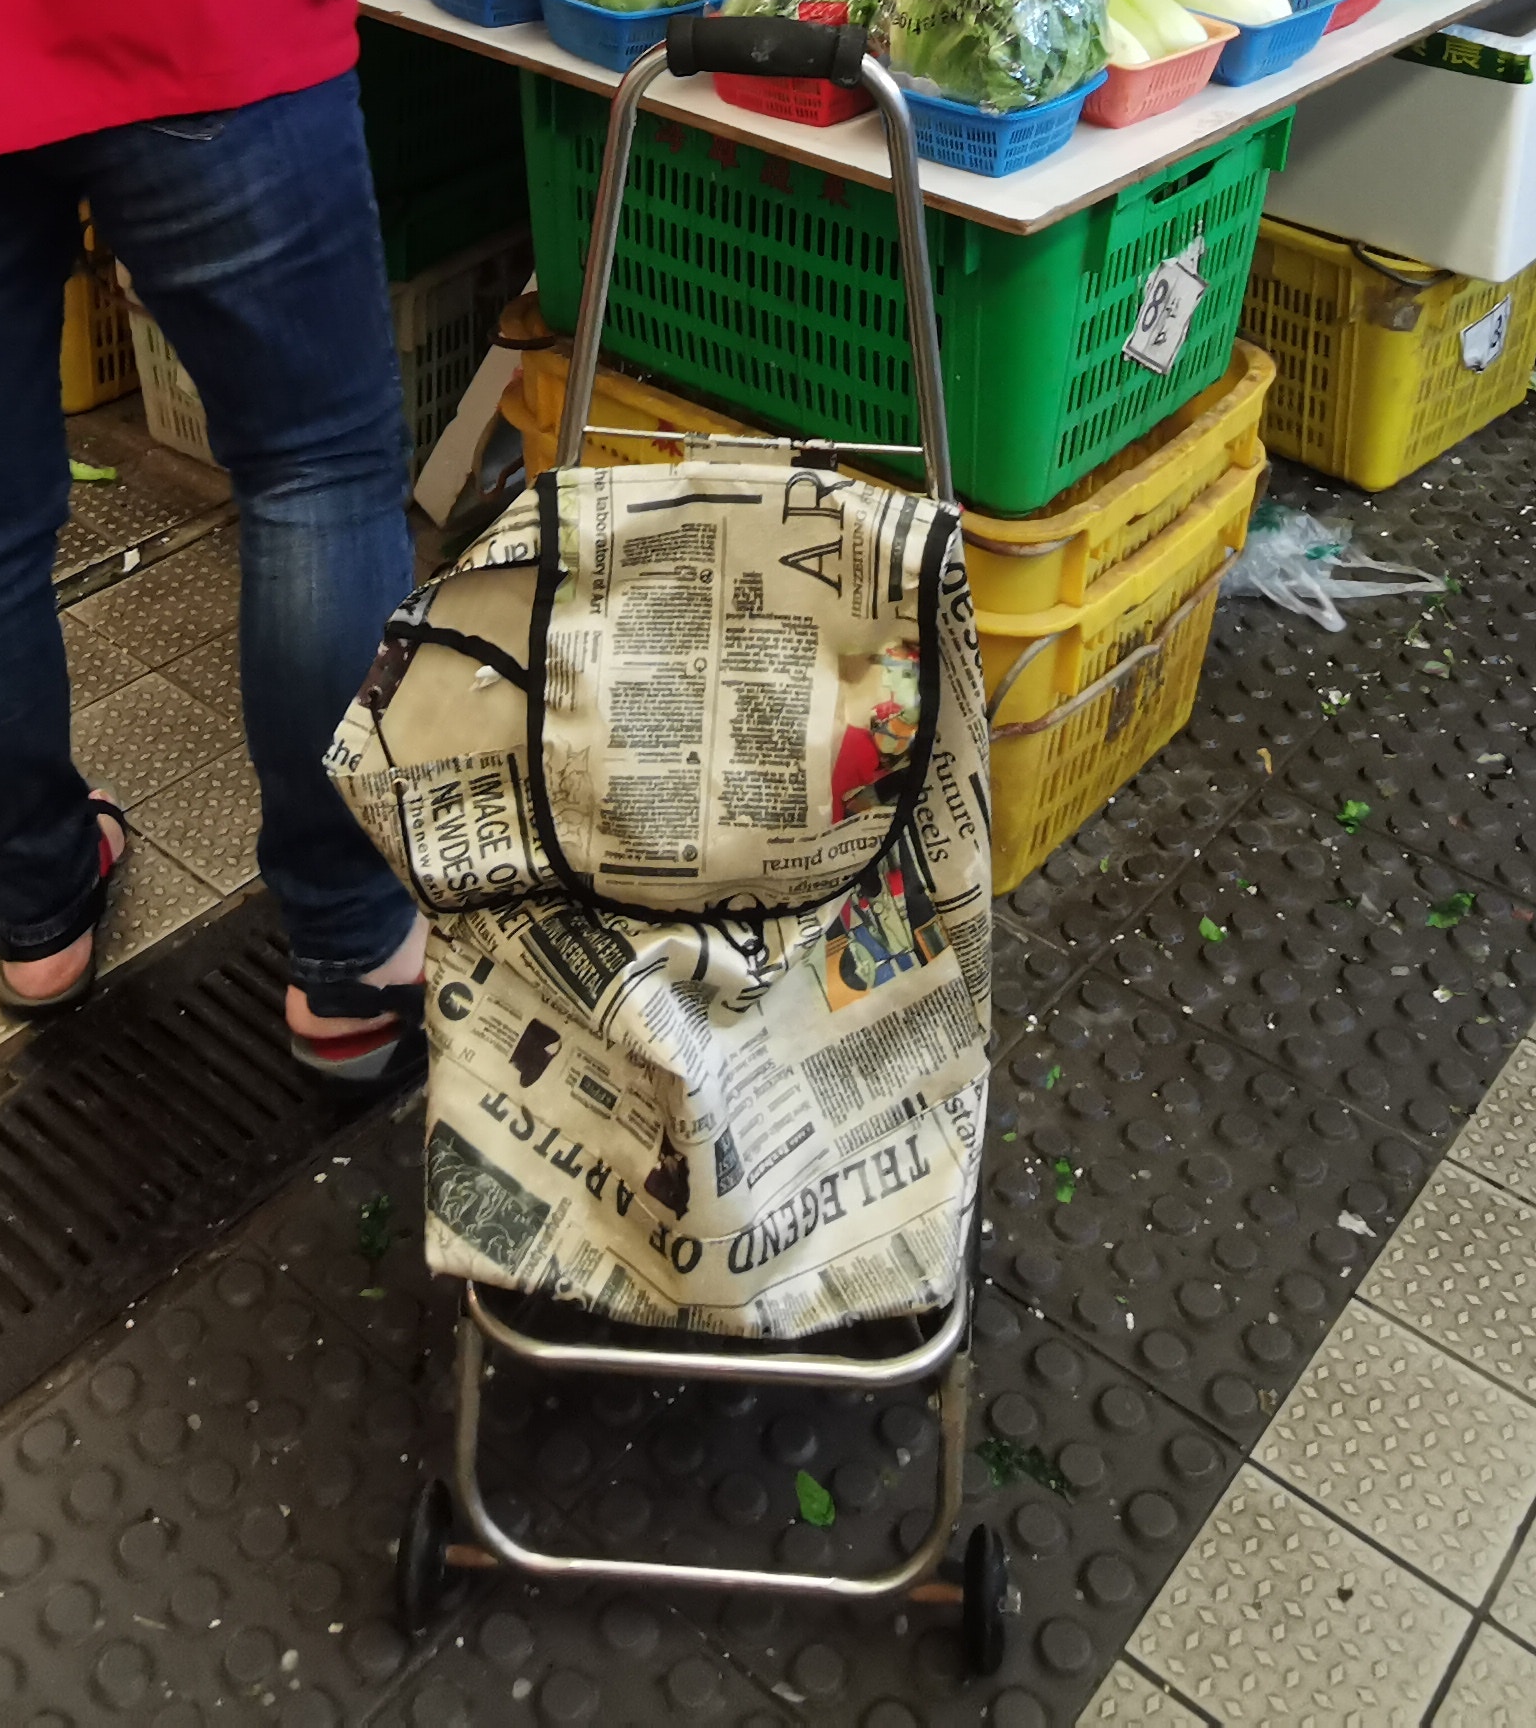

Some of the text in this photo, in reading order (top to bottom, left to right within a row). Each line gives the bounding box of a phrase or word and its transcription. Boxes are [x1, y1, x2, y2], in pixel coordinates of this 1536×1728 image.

[468, 771, 513, 859] IMAGE
[762, 847, 823, 875] plural
[478, 1091, 635, 1217] ARTIST
